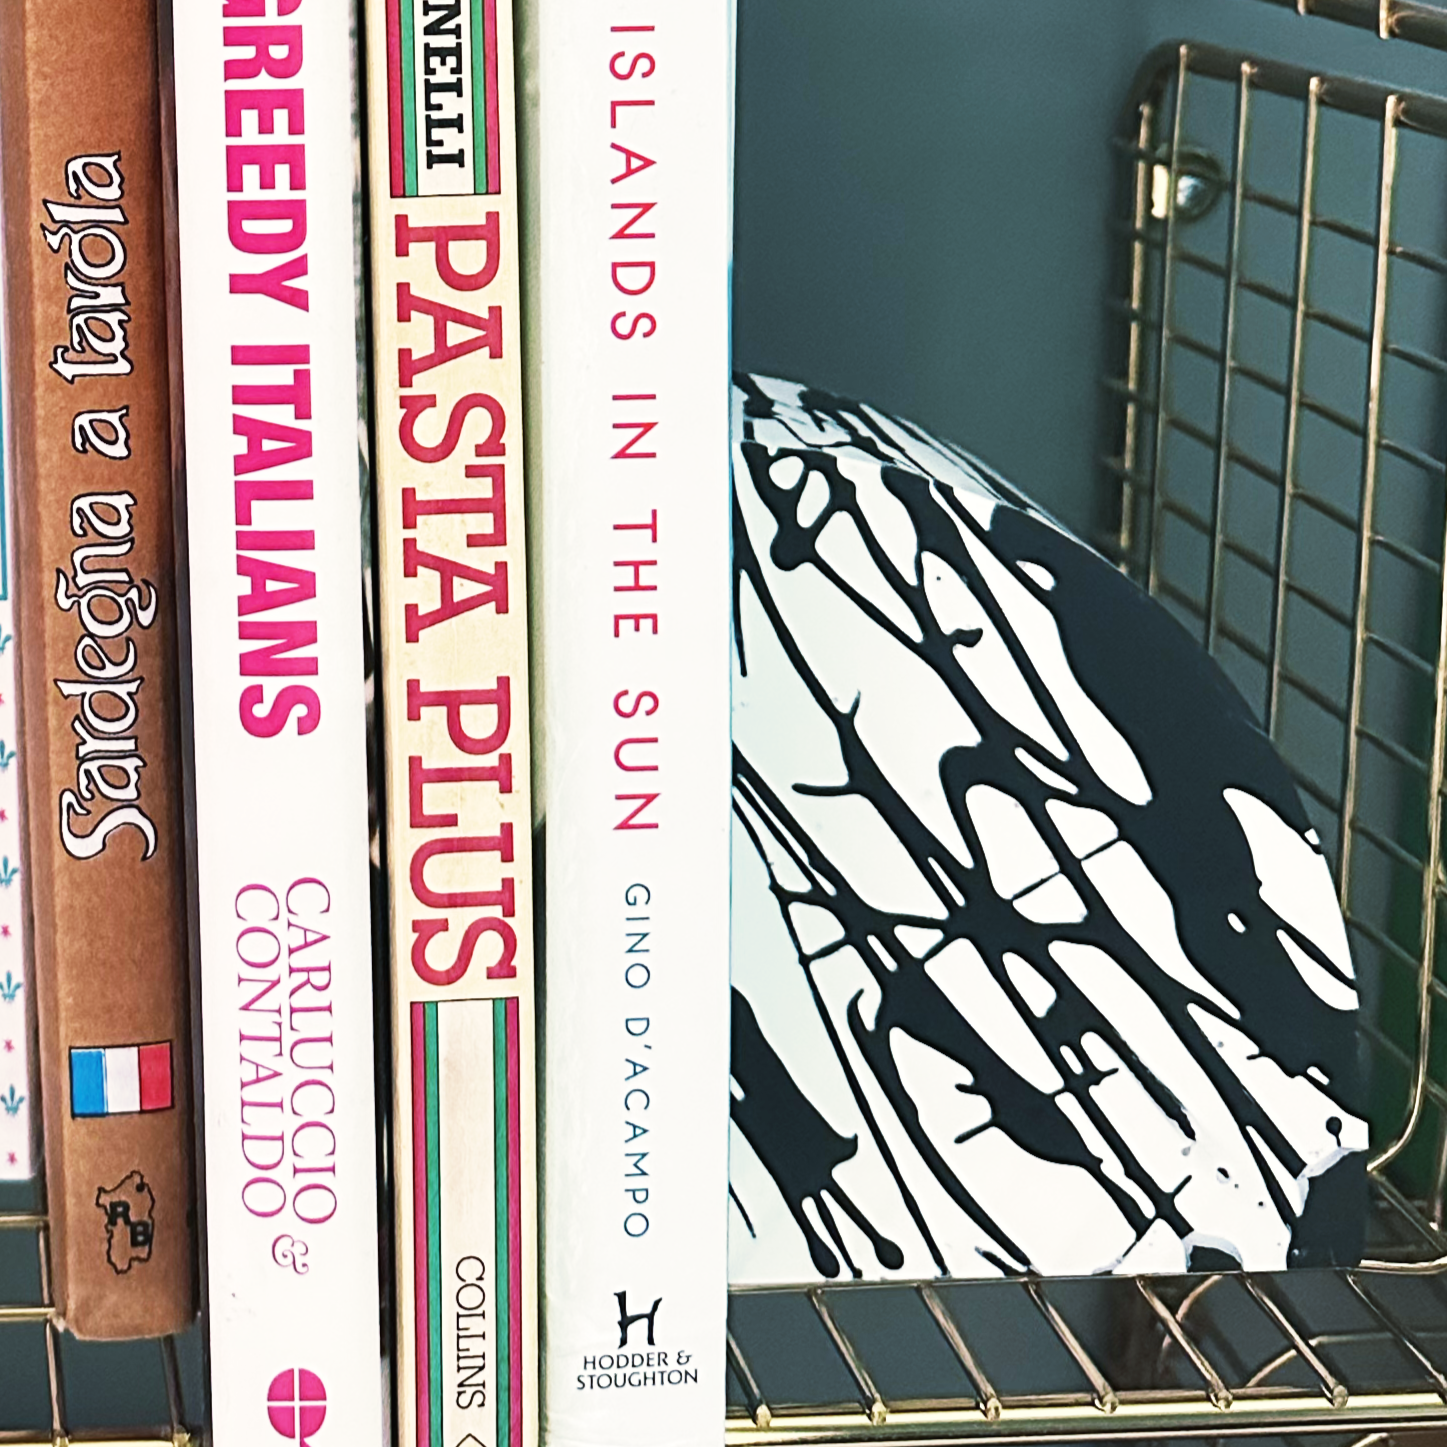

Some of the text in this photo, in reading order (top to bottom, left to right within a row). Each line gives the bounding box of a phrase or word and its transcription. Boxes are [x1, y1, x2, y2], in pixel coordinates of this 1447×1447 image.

[609, 25, 658, 341] ISLANDS
[40, 150, 158, 861] Sardegna a tavola
[230, 344, 322, 739] ITALIANS
[610, 393, 659, 460] IN
[612, 508, 659, 638] THE
[394, 210, 518, 986] PASTA PLUS
[612, 689, 661, 830] SUN
[235, 883, 287, 1219] CONTALDO
[271, 876, 337, 1275] CARLUCCIO &
[623, 883, 652, 1238] GINO D'ACAMPO
[455, 1255, 486, 1410] COLLINS
[576, 1368, 698, 1390] STOUGHTON
[583, 1350, 692, 1371] HODDER &
